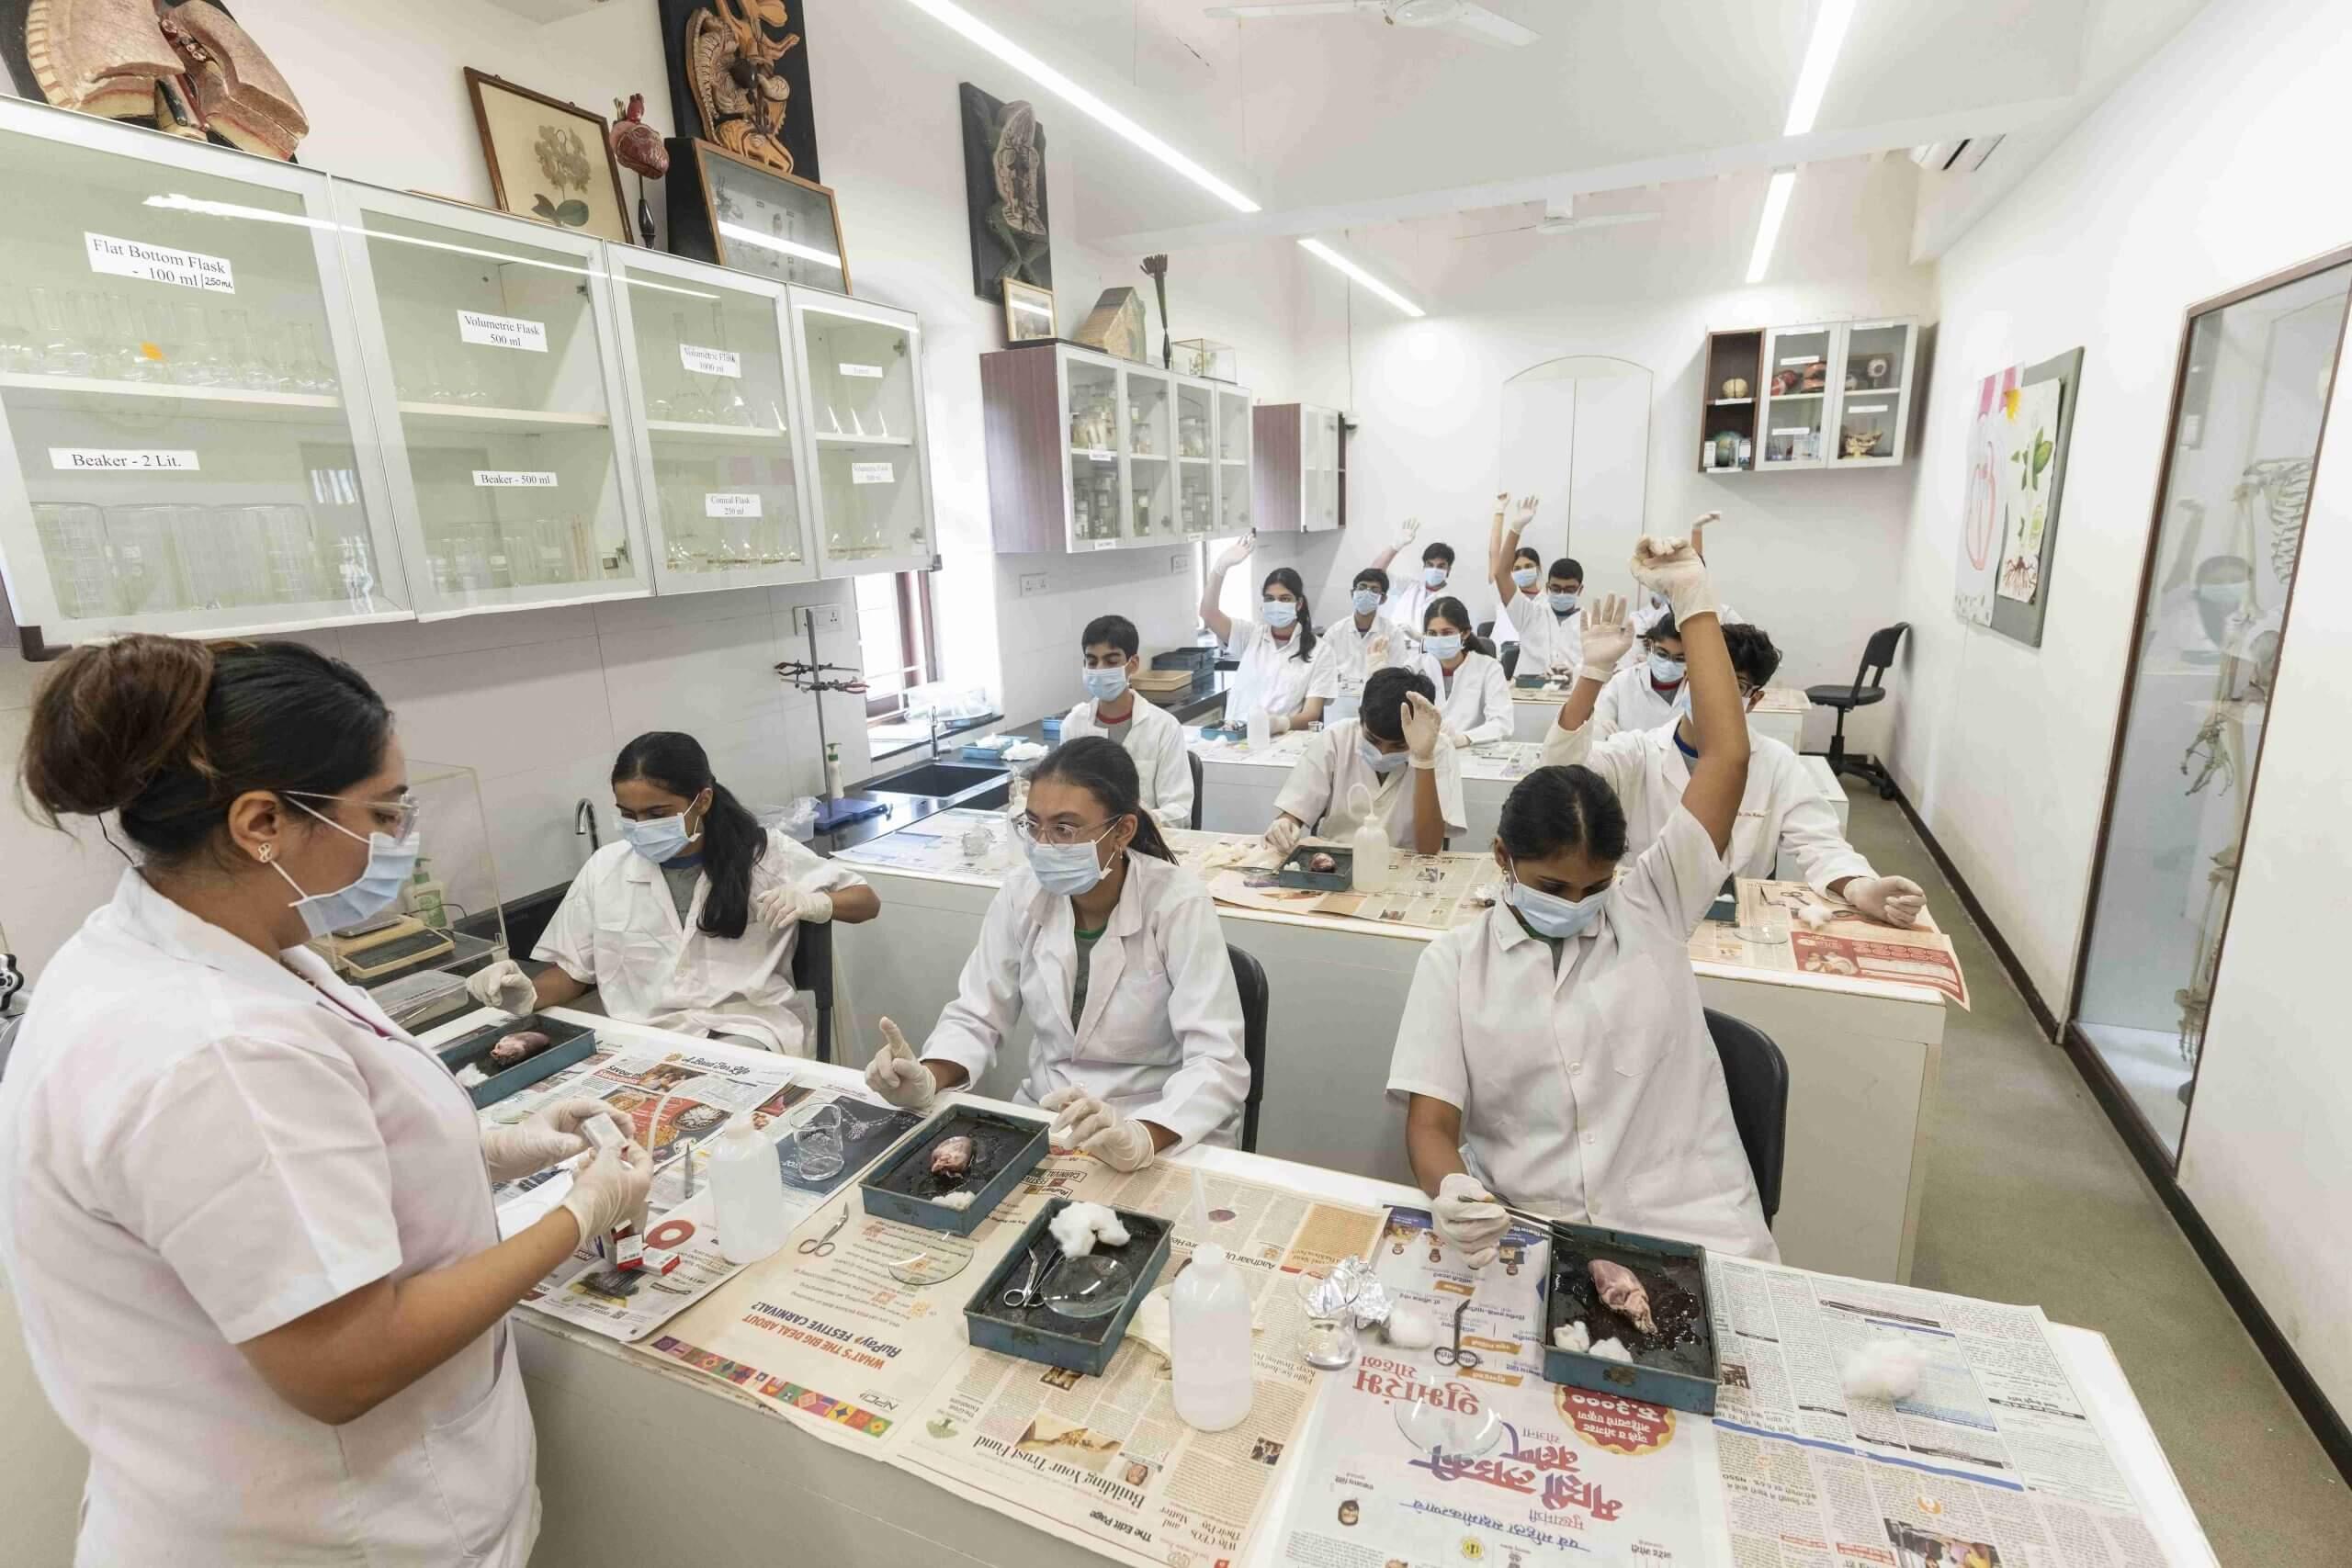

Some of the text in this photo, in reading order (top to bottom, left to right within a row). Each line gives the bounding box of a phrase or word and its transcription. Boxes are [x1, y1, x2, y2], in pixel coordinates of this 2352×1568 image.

[93, 239, 226, 274] Flat Bottom Flask
[149, 267, 175, 282] 100
[180, 274, 198, 287] ml
[464, 315, 540, 335] Volumetric Flask
[491, 333, 522, 347] 500 ml
[72, 454, 128, 468] Beaker
[142, 455, 152, 467] 2
[155, 455, 182, 467] Lit.
[481, 474, 512, 484] Beaker
[521, 475, 537, 484] 500
[538, 475, 550, 484] ml
[1239, 1256, 1277, 1269] Aadhaar
[751, 1301, 902, 1359] RuPay FESTIVE CARNIVAL?
[742, 1314, 886, 1370] WHAT'S THE BIG DEAL ABOUT
[1360, 1356, 1418, 1380] सोहळा
[1352, 1369, 1480, 1416] शुभारंभ
[1522, 1427, 1560, 1443] योजना
[973, 1436, 1145, 1508] Building Your Trust Fund
[1408, 1444, 1537, 1495] लाडकी
[1090, 1510, 1152, 1542] The Edit Page
[1507, 1523, 1553, 1546] महिला
